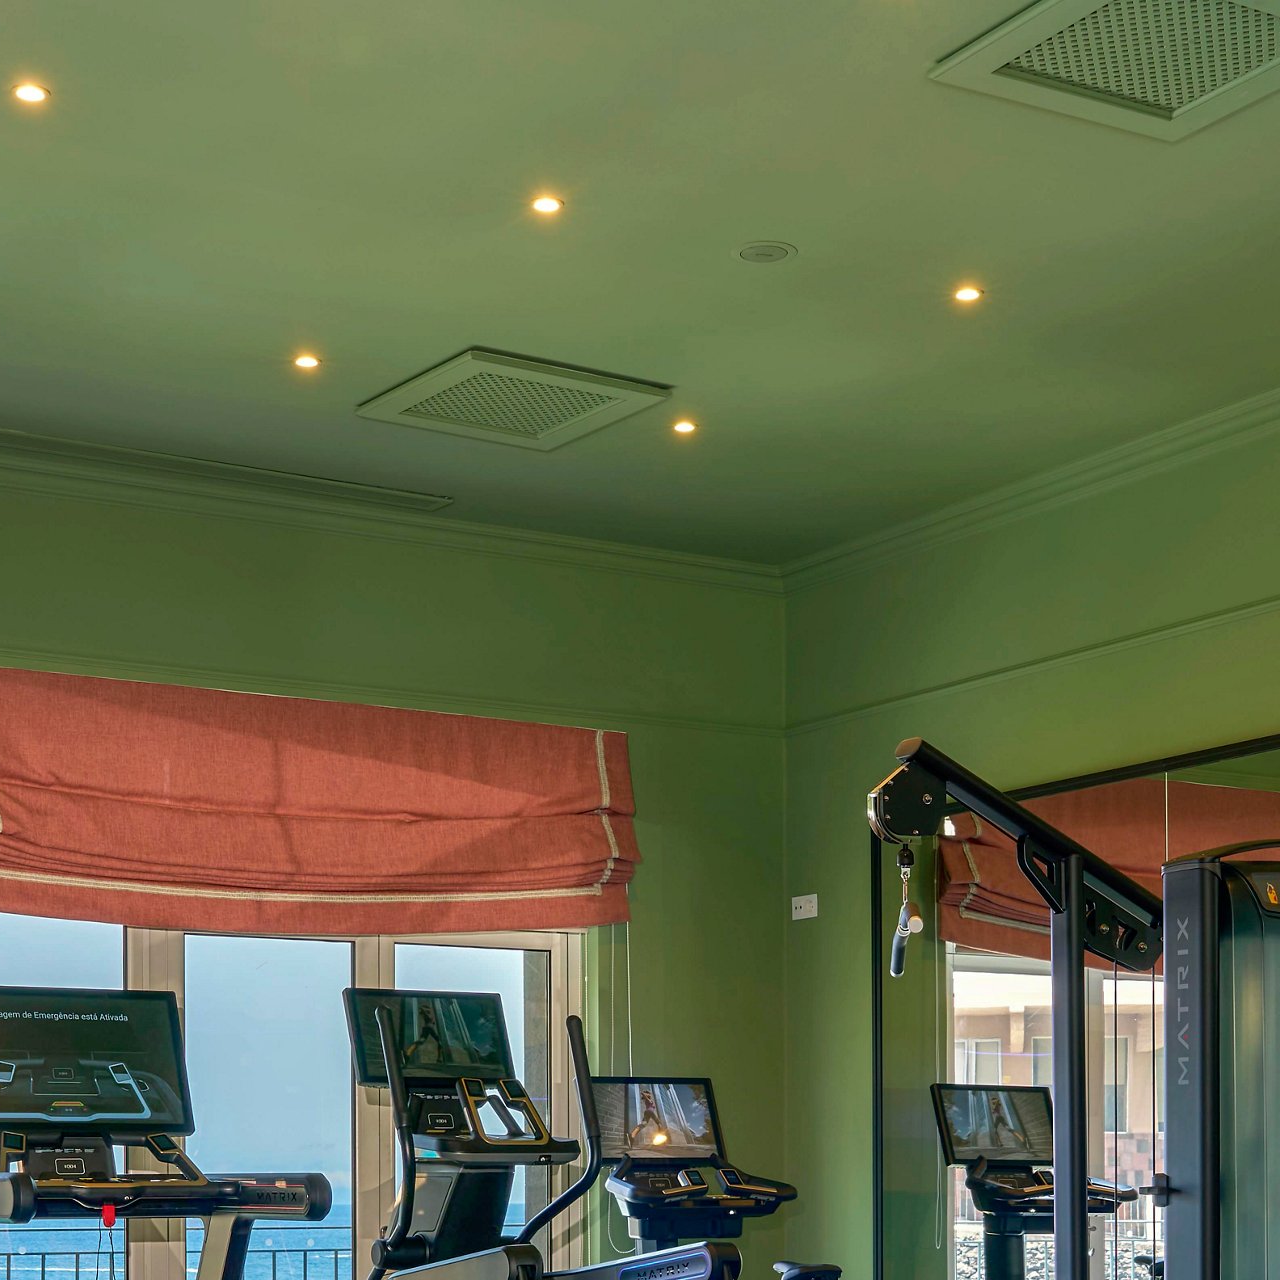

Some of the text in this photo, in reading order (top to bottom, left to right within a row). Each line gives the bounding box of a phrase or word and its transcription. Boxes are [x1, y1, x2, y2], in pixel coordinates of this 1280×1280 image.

[1176, 916, 1190, 1086] MATRIX
[22, 1011, 32, 1019] de
[34, 1011, 80, 1021] Emergência
[81, 1013, 98, 1021] está
[99, 1013, 129, 1022] Ativada
[256, 1191, 298, 1202] MATRIX
